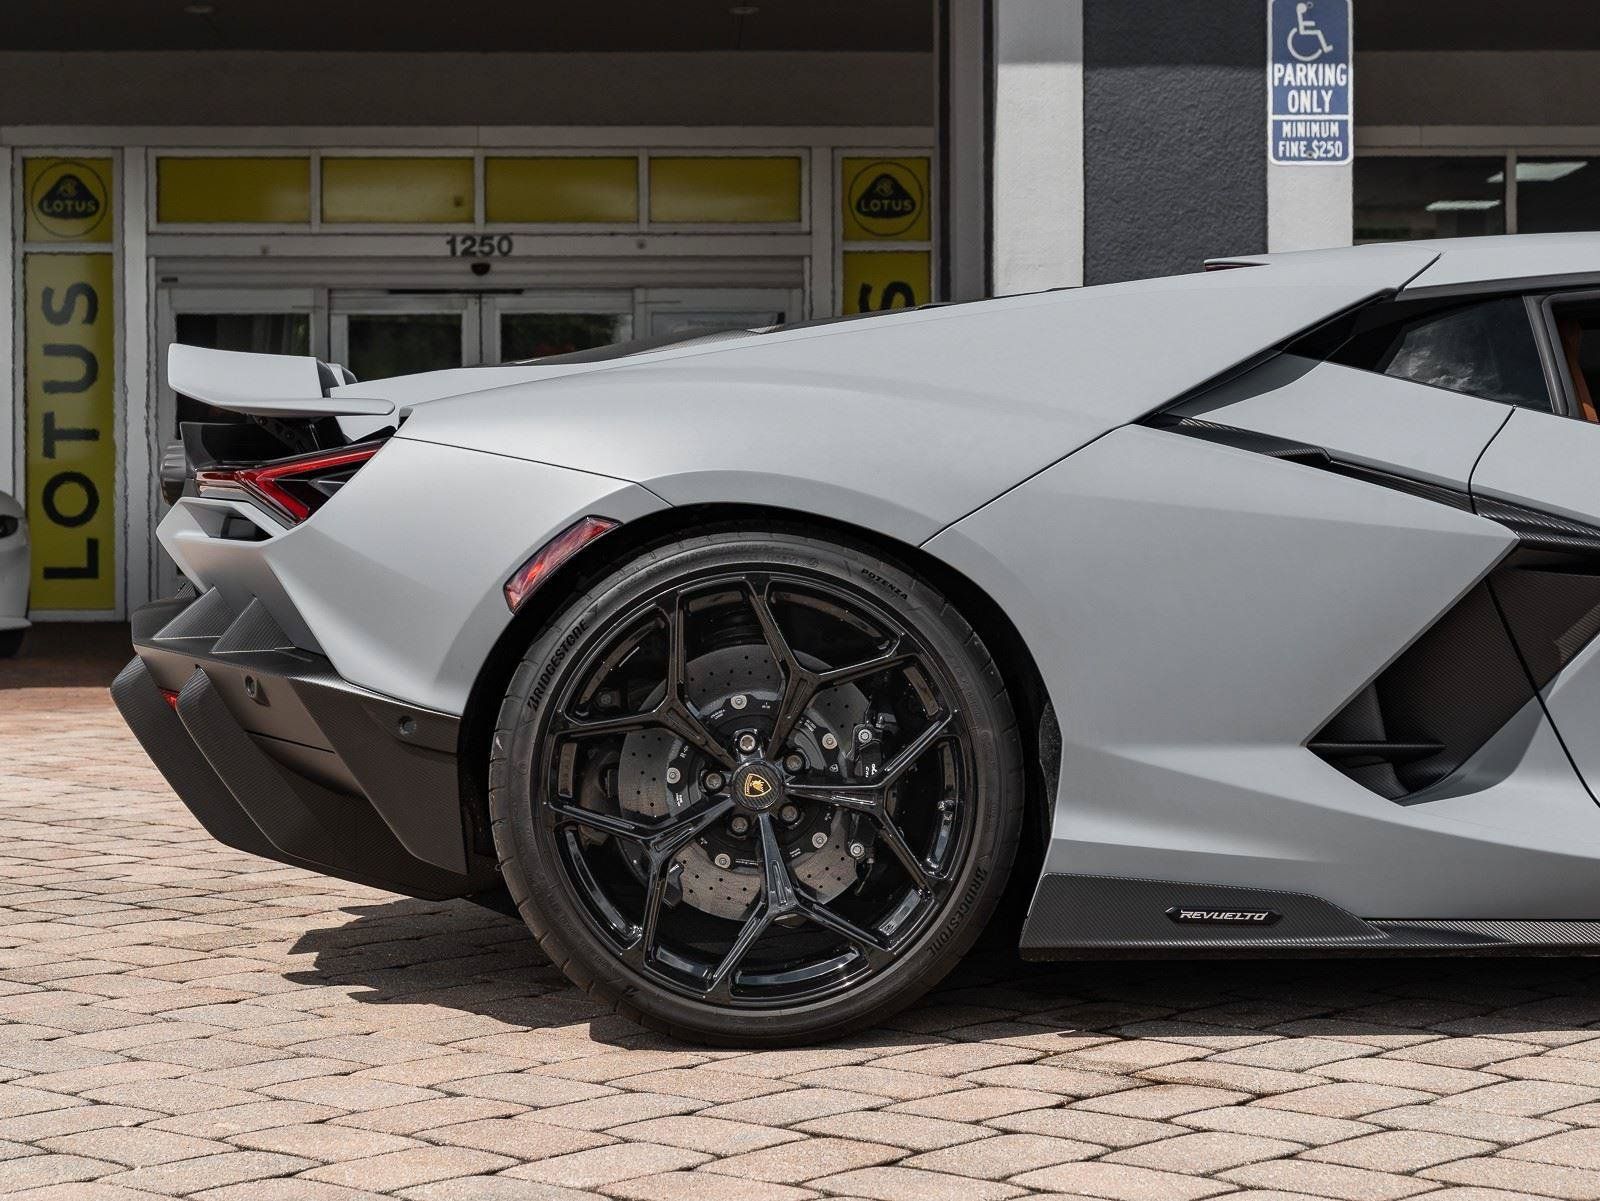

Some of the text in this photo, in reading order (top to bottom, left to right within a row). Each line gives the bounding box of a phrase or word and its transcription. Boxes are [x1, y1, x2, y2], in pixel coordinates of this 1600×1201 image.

[1273, 63, 1347, 87] PARKING
[1287, 89, 1333, 113] ONLY
[1282, 121, 1339, 138] MINIMUM
[1278, 139, 1343, 159] FINE $250
[42, 200, 96, 213] LOTUS
[860, 199, 912, 212] LOTUS
[446, 235, 513, 257] 1250
[42, 282, 99, 580] LOTUS
[861, 568, 908, 600] POTENZA
[527, 619, 589, 712] BRIDGESTONE
[926, 866, 988, 956] BRIDGESTONE
[1180, 909, 1268, 920] REVUELTO
